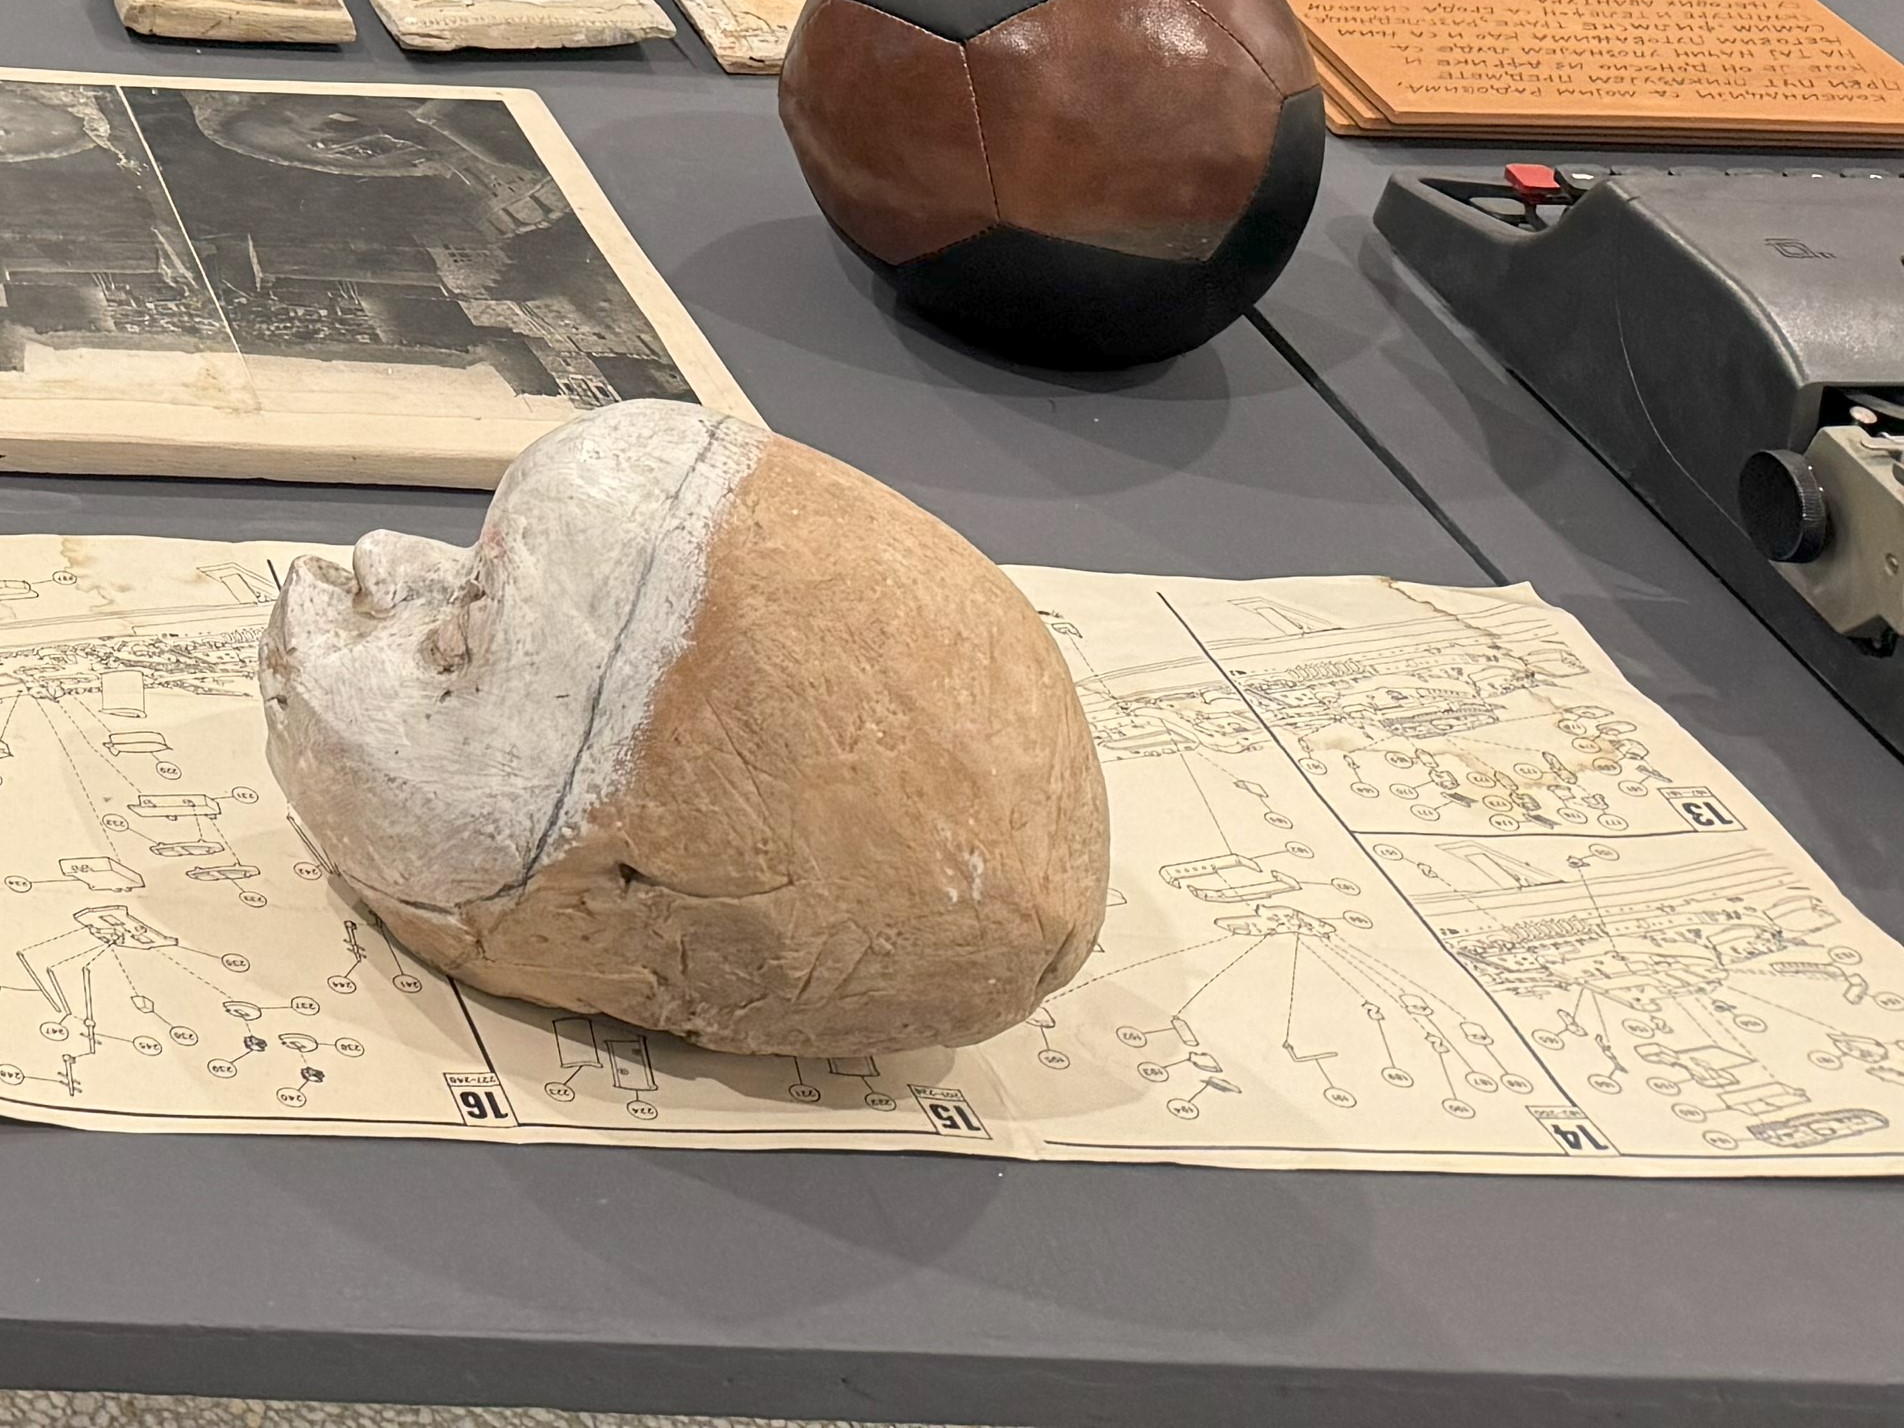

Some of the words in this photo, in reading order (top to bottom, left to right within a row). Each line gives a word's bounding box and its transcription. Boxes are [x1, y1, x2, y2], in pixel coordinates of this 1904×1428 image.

[1556, 88, 1636, 100] МОЈИМ
[1763, 78, 1815, 89] ПУТ
[1681, 801, 1735, 827] 13
[459, 1090, 509, 1120] 16
[928, 1103, 982, 1132] 15
[1551, 1123, 1610, 1151] 14
